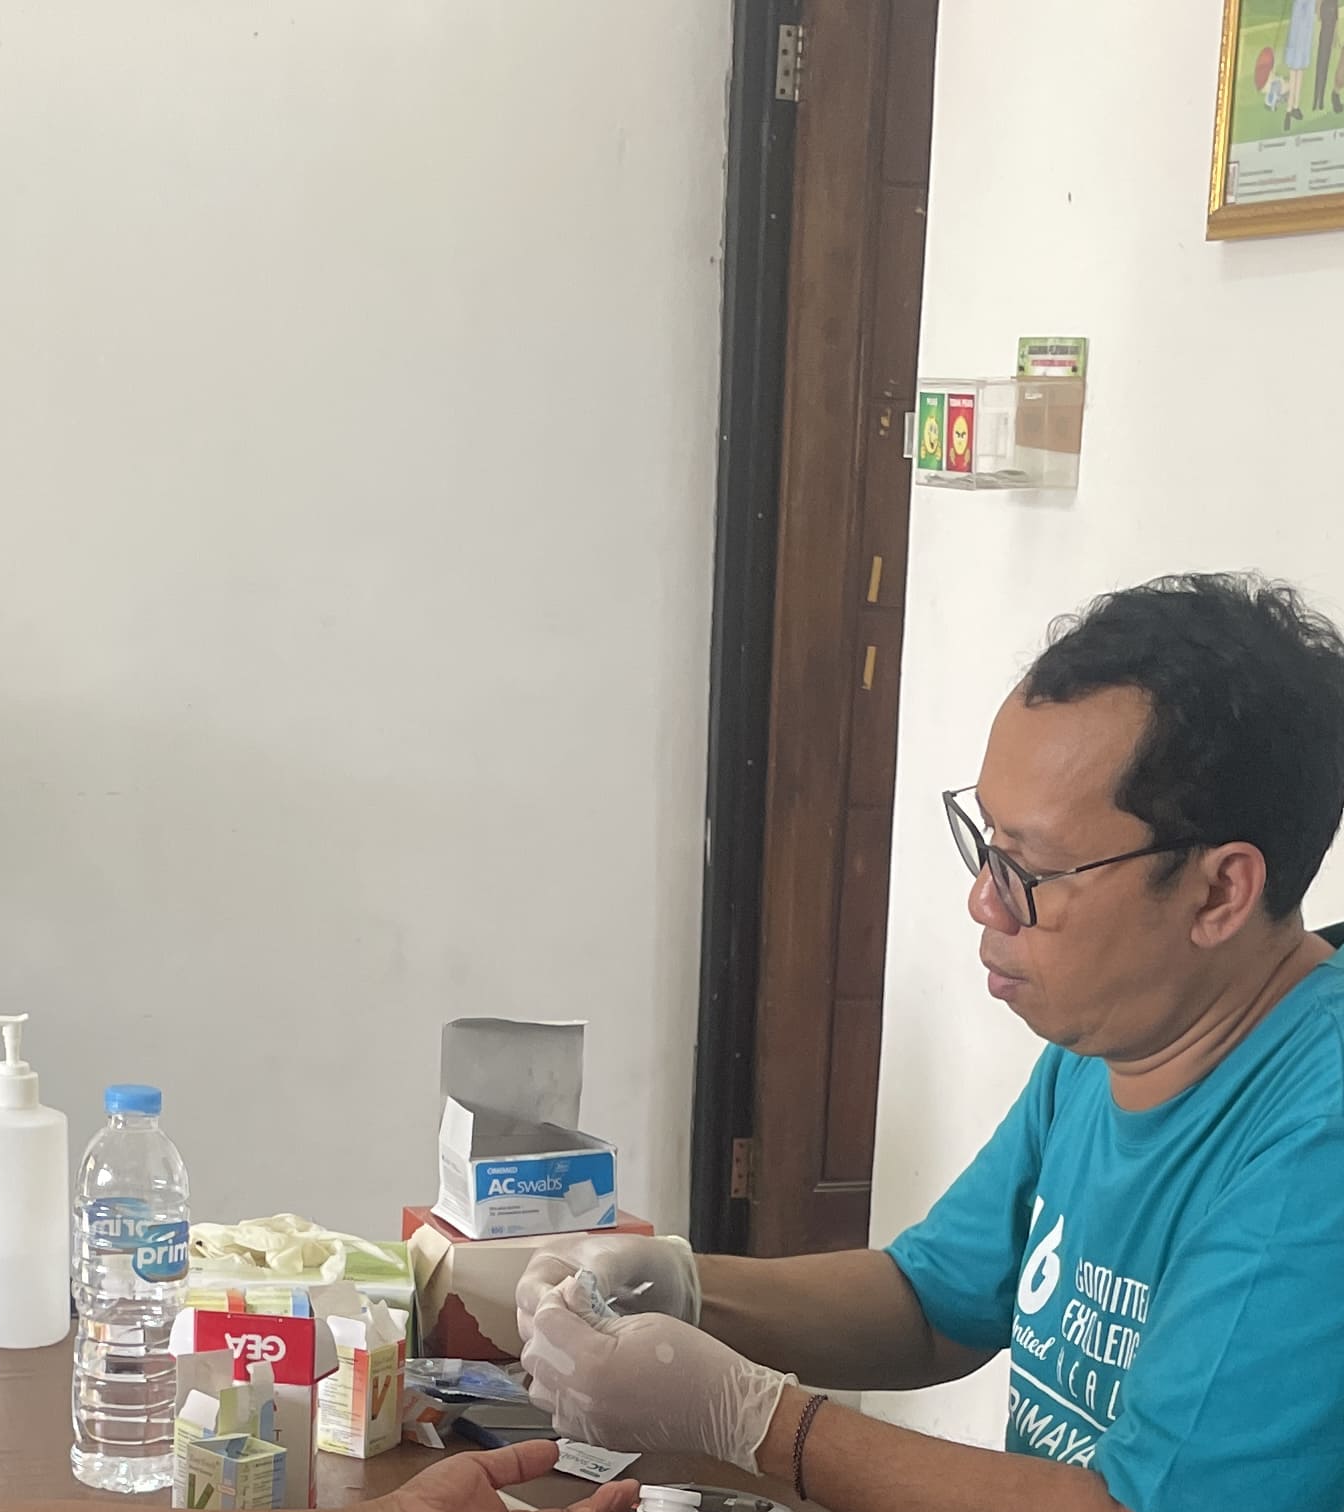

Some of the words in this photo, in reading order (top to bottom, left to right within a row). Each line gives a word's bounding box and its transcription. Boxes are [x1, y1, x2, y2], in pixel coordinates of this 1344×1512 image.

[488, 1178, 516, 1195] AC
[517, 1175, 563, 1194] swabs
[224, 1332, 287, 1363] GEA
[1009, 1385, 1096, 1468] RIMAYA
